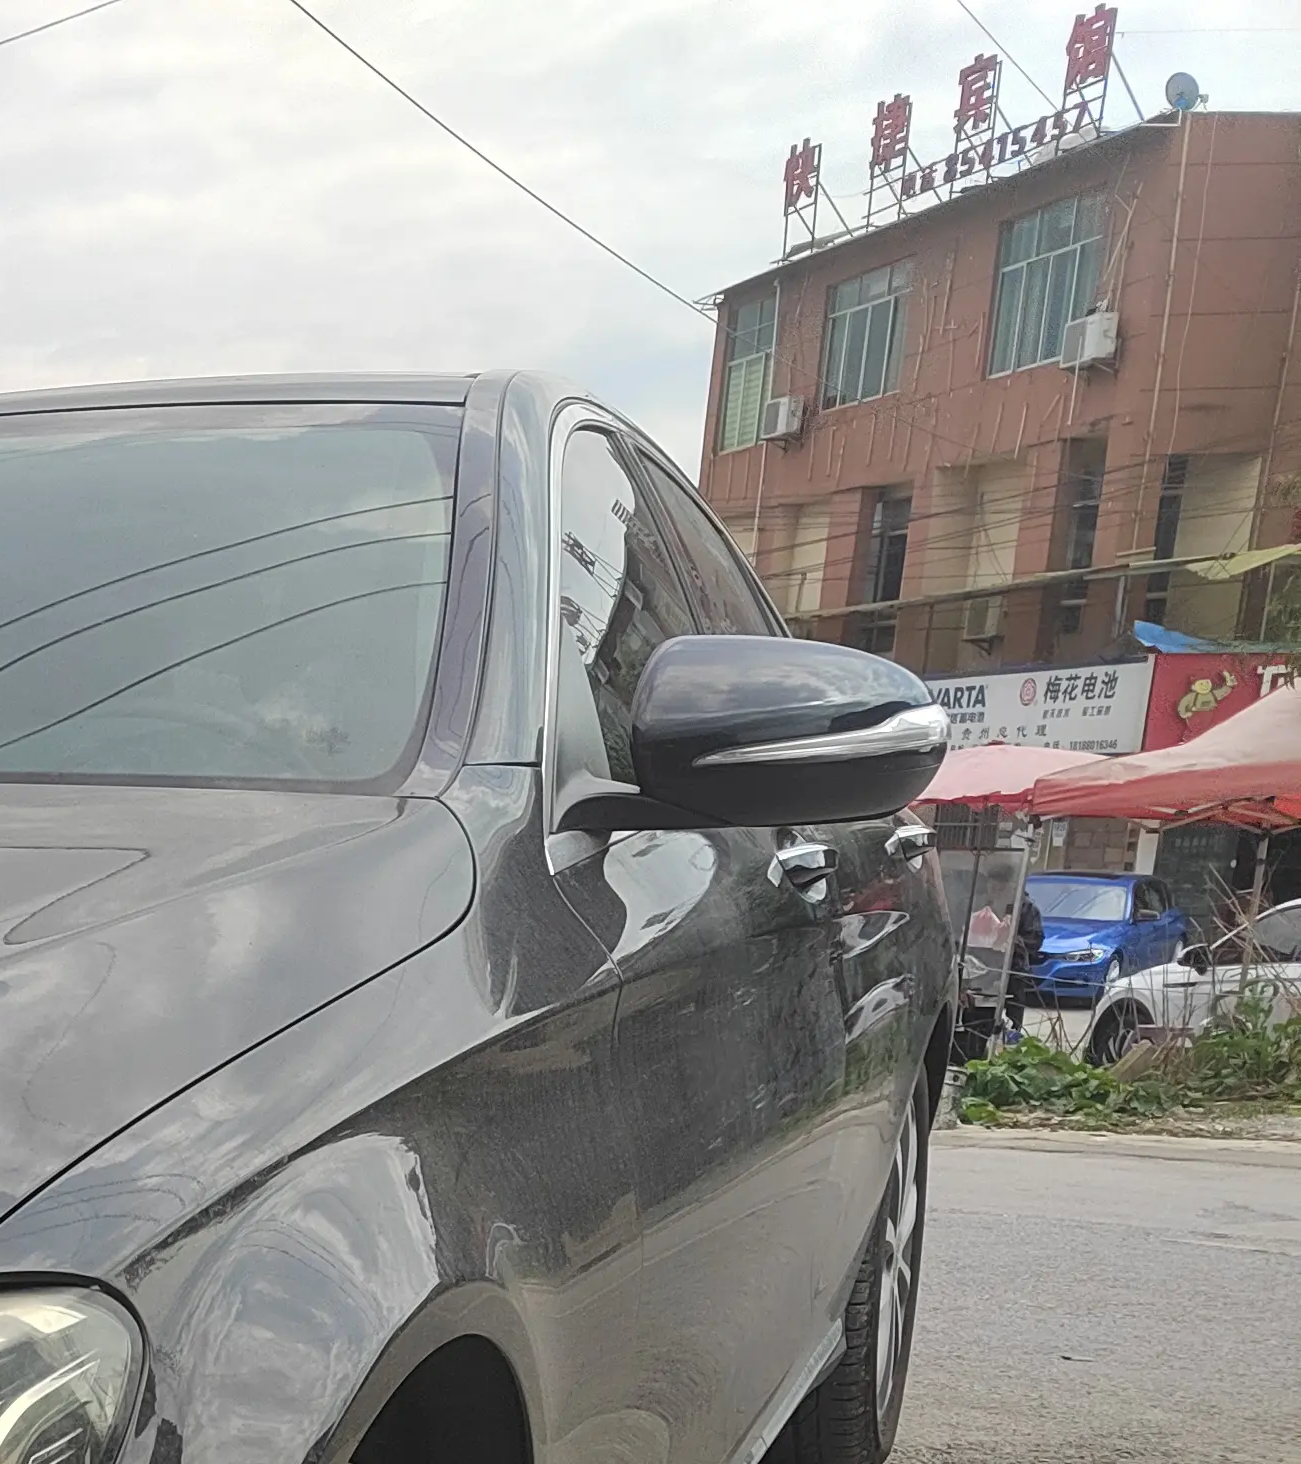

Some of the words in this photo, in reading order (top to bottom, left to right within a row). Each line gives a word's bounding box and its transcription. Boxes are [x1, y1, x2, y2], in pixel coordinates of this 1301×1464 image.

[784, 3, 1117, 206] 快捷宾馆
[1043, 670, 1118, 704] 梅花电池
[946, 711, 986, 725] 塔蓄电池
[946, 724, 1047, 741] 贵州总代理
